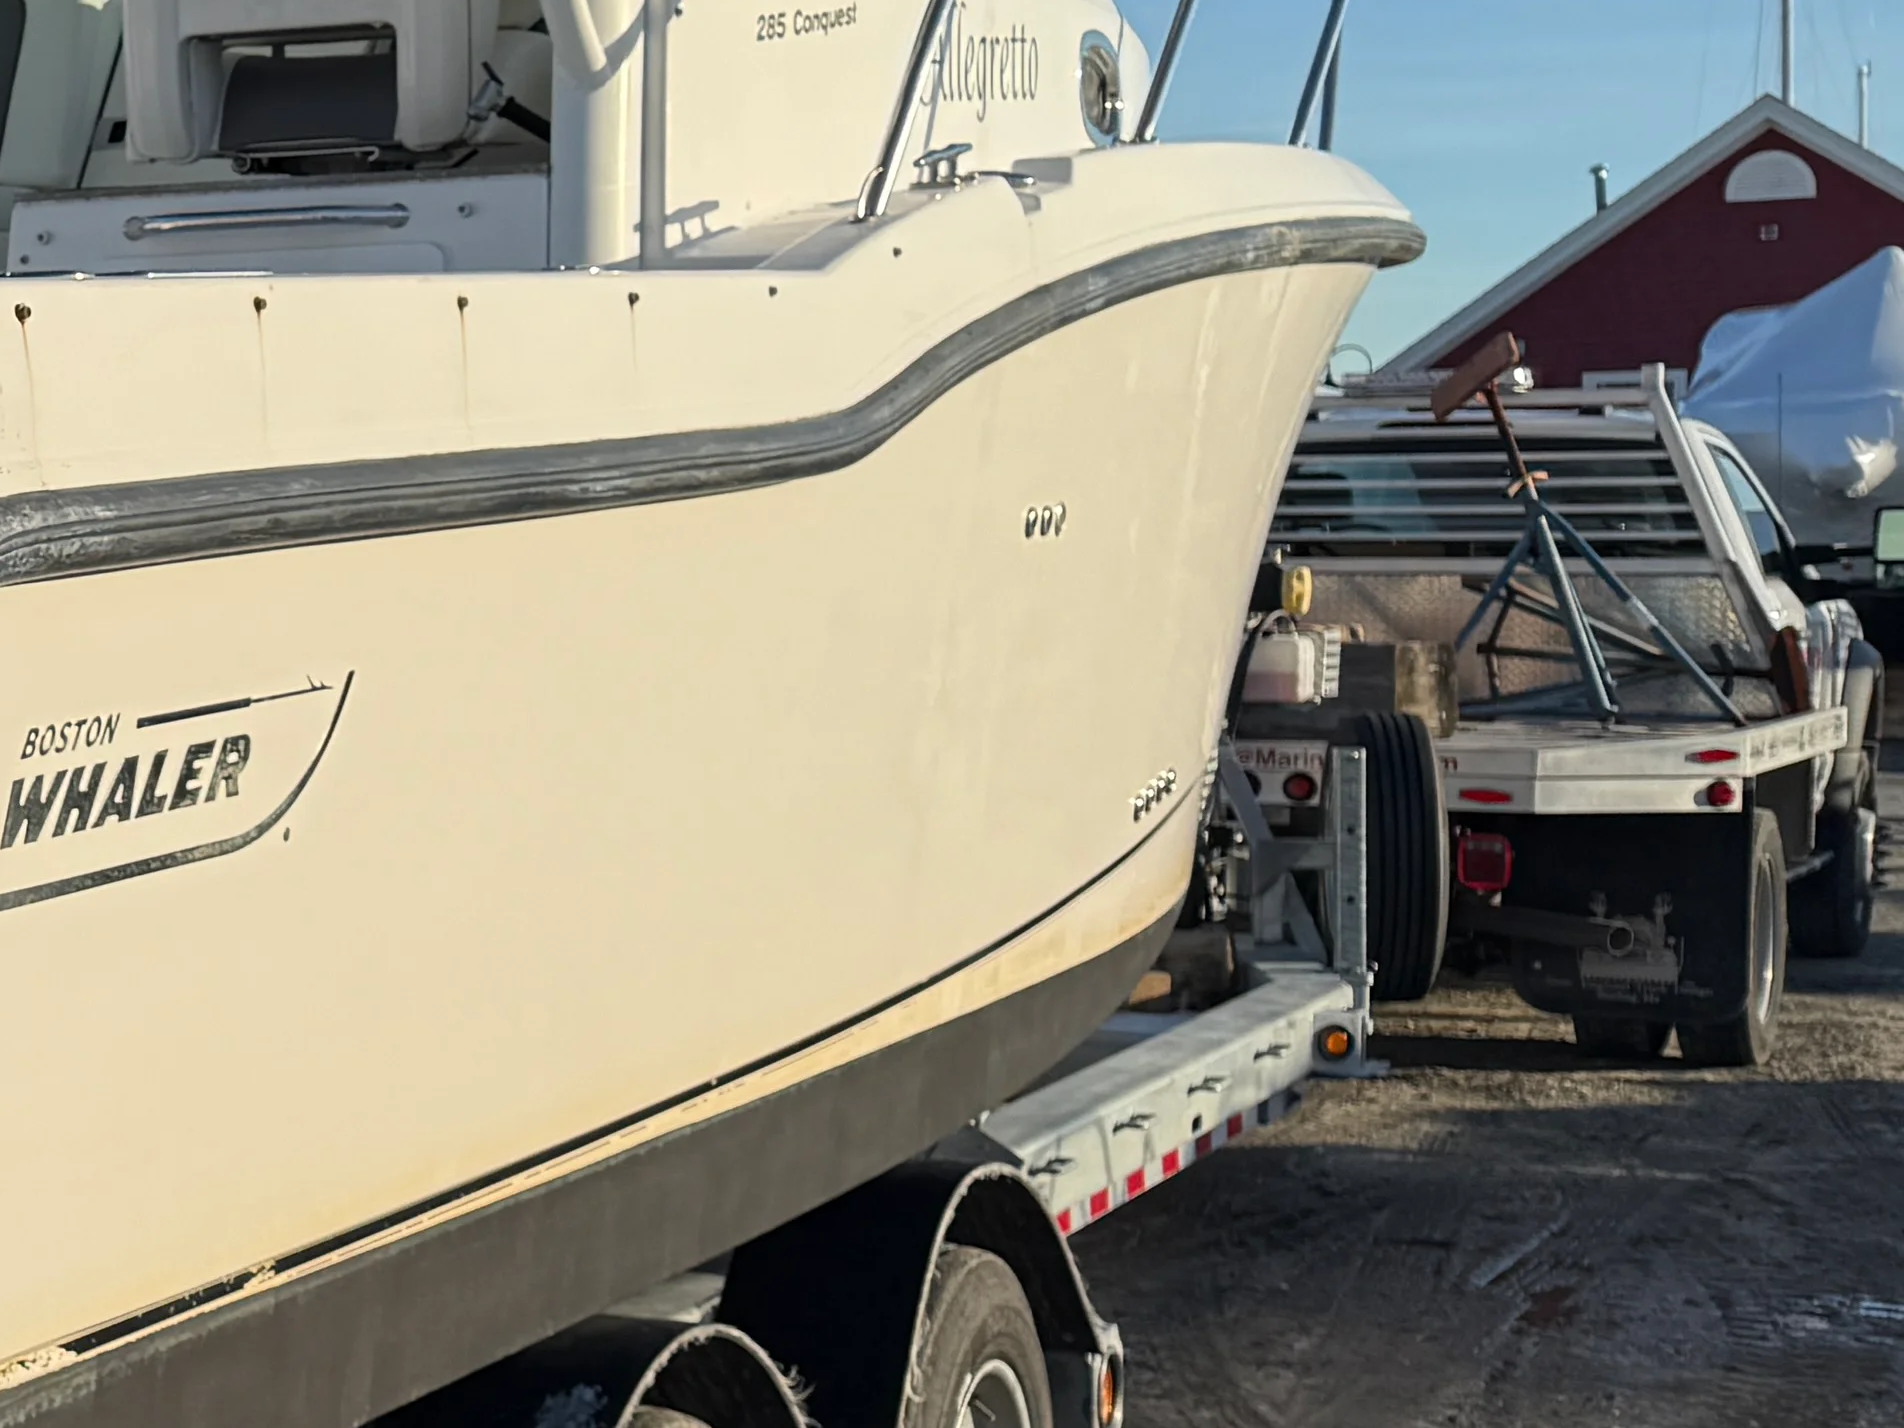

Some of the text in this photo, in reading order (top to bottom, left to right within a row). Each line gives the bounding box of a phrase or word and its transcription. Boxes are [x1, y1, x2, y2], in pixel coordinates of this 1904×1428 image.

[755, 1, 858, 42] 285 Conquest
[20, 712, 121, 760] BOSTON
[0, 733, 251, 851] WHALER
